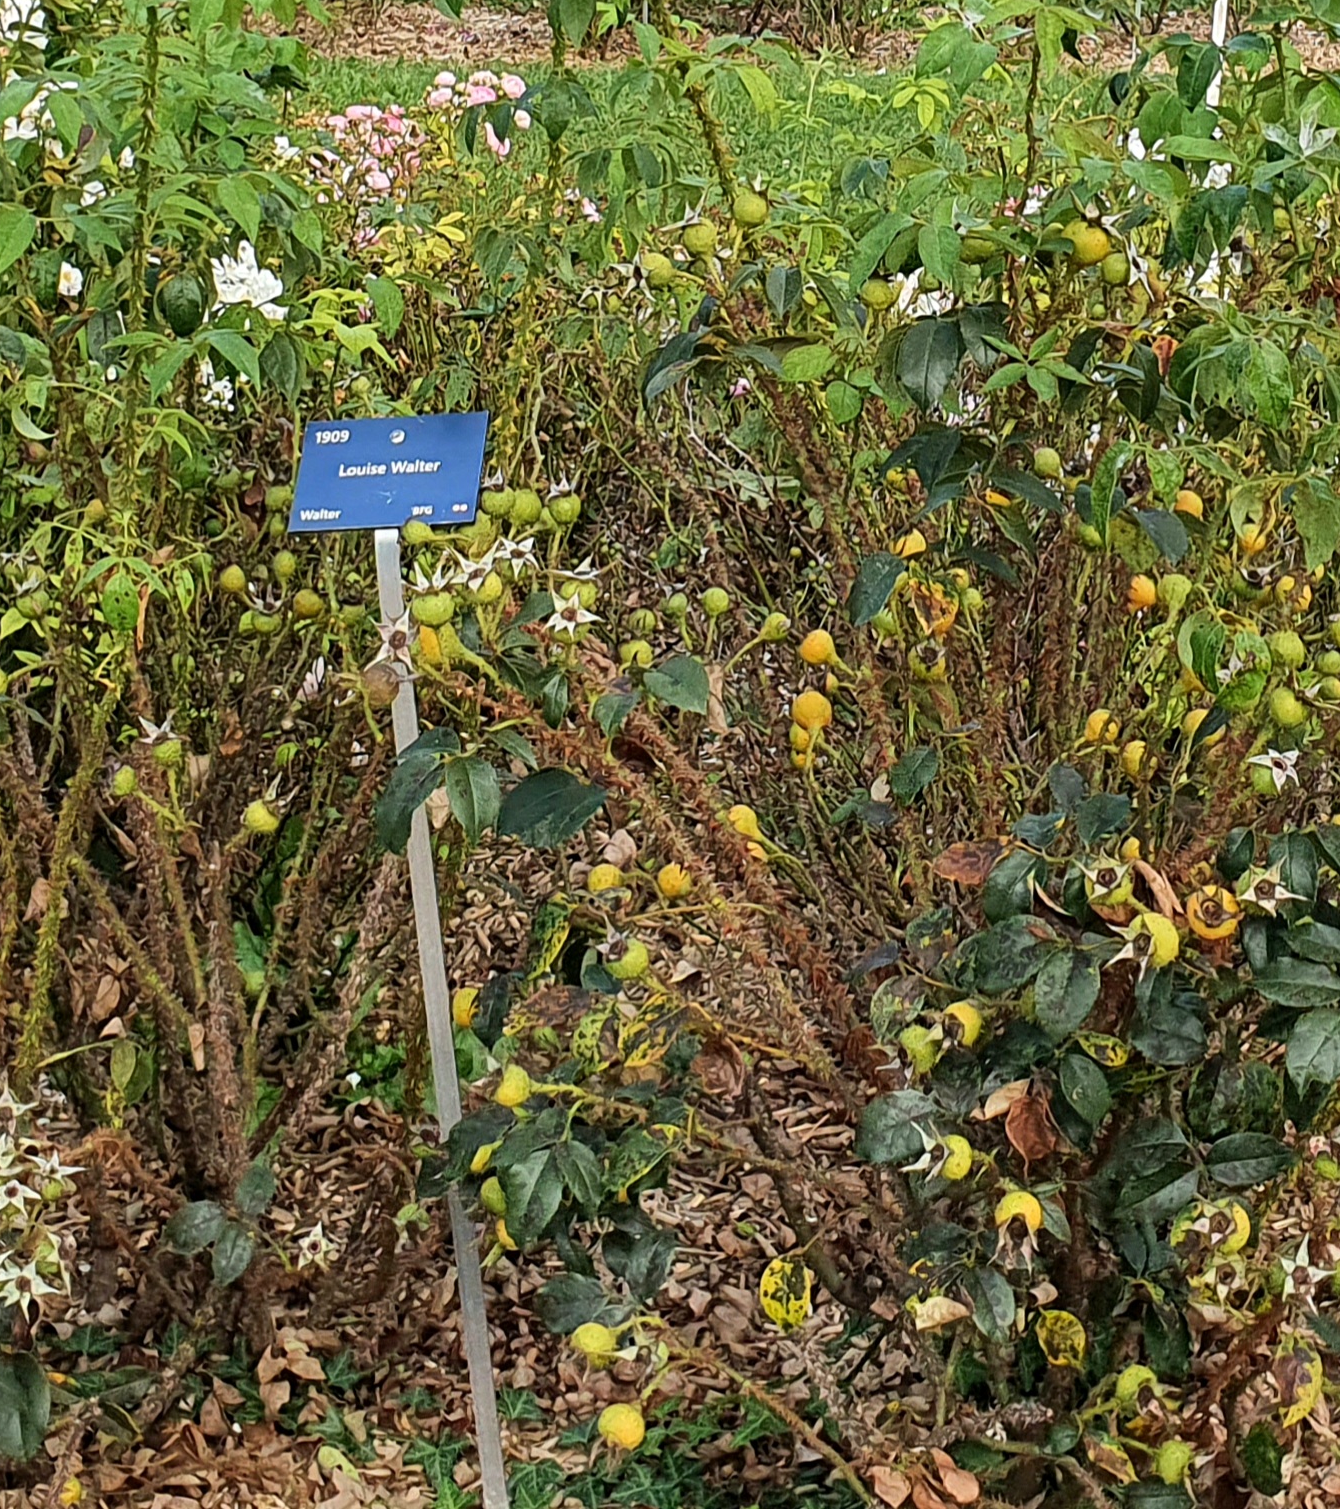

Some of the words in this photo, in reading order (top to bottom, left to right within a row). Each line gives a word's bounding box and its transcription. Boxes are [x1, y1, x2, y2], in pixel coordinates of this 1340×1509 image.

[315, 429, 350, 444] 1909
[339, 461, 387, 477] Louise
[391, 458, 441, 474] Walter
[300, 508, 341, 521] Walter
